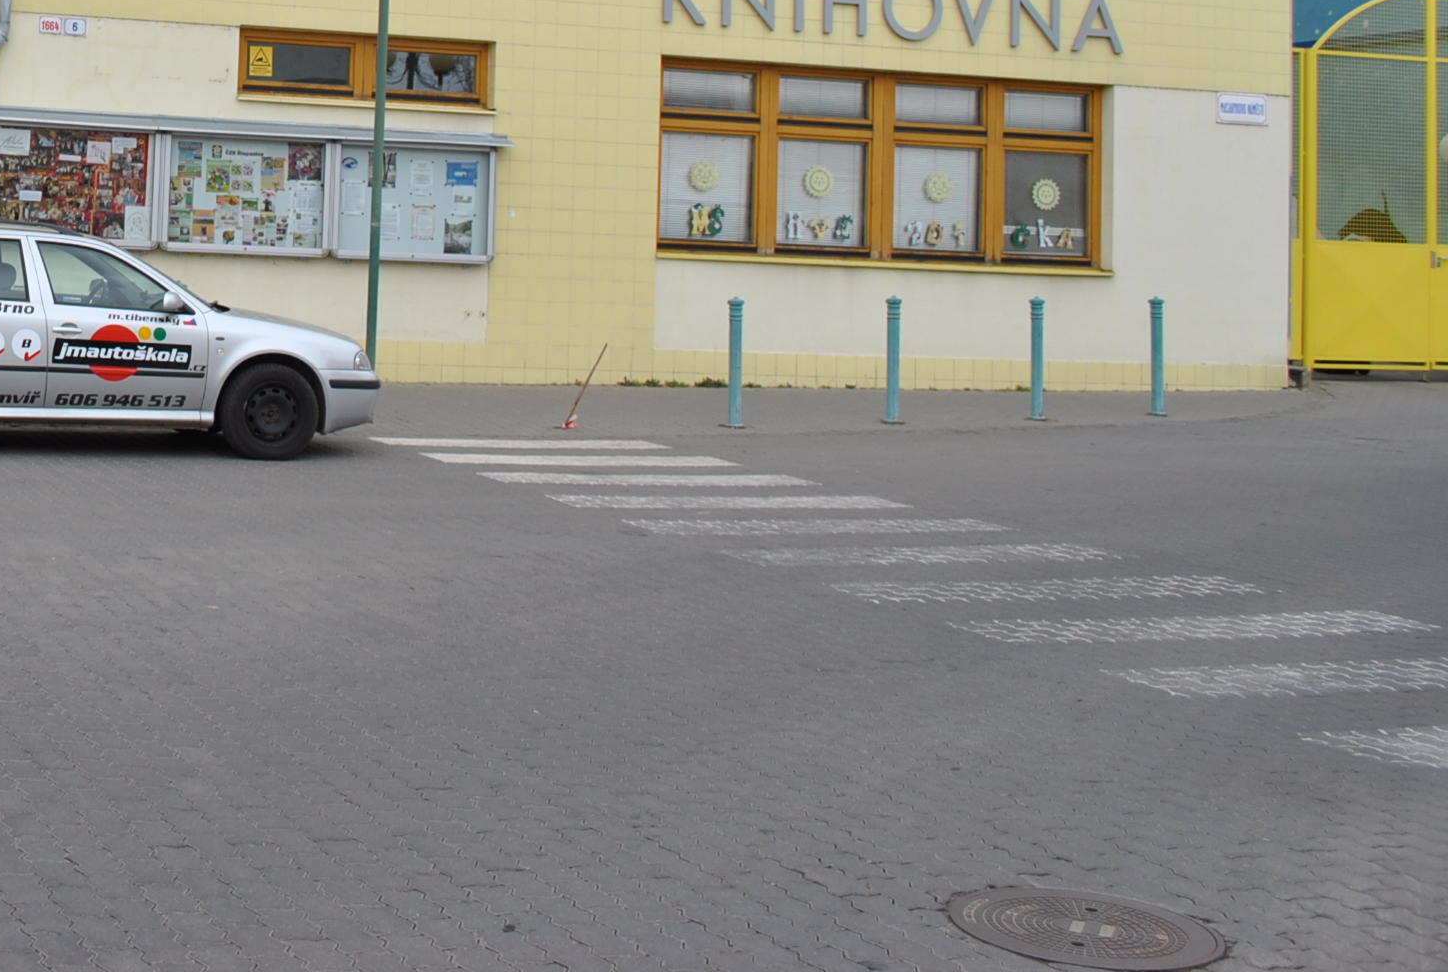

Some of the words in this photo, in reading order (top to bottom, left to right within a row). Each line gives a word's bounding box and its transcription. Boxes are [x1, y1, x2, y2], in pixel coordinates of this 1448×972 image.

[72, 22, 78, 32] 6
[21, 338, 32, 348] B
[54, 342, 189, 363] jmautoškola
[55, 393, 98, 407] 606
[102, 394, 145, 407] 946
[147, 395, 186, 408] 513
